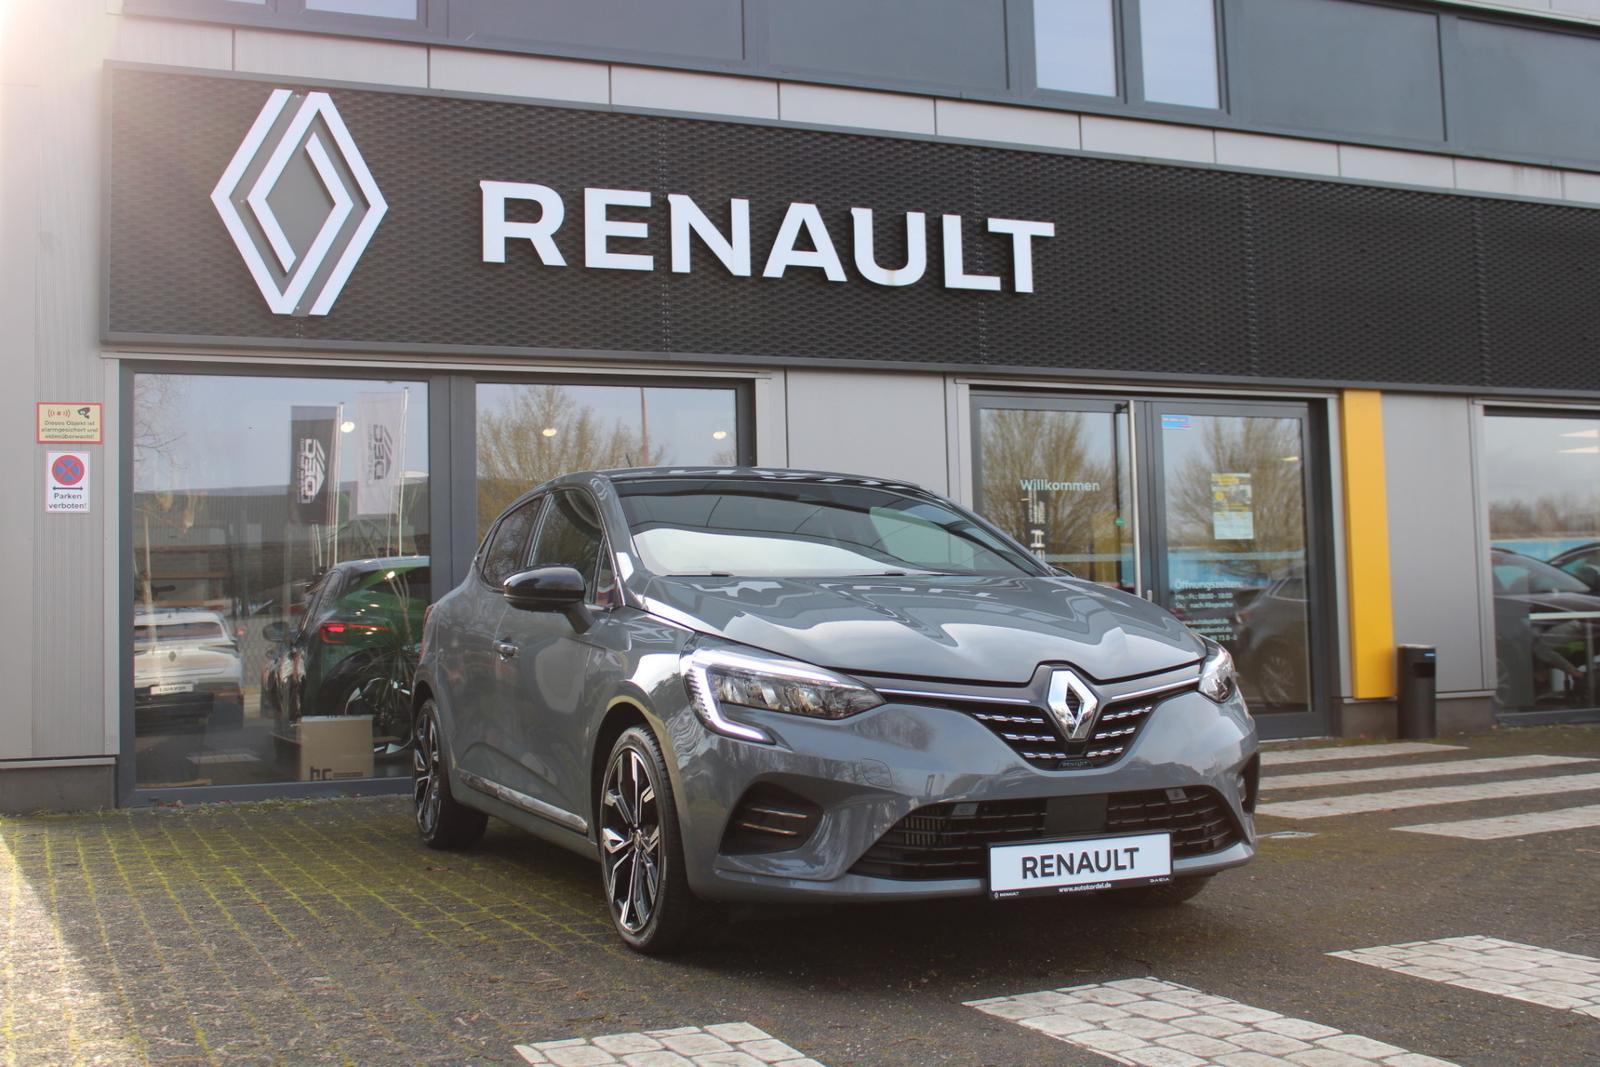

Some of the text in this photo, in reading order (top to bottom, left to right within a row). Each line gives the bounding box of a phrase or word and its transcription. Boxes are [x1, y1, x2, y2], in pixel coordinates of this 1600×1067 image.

[479, 180, 1055, 293] RENAULT
[1020, 479, 1100, 491] Willkommen
[53, 492, 82, 500] Parken
[48, 502, 87, 510] verboten!
[1021, 847, 1140, 879] RENAULT
